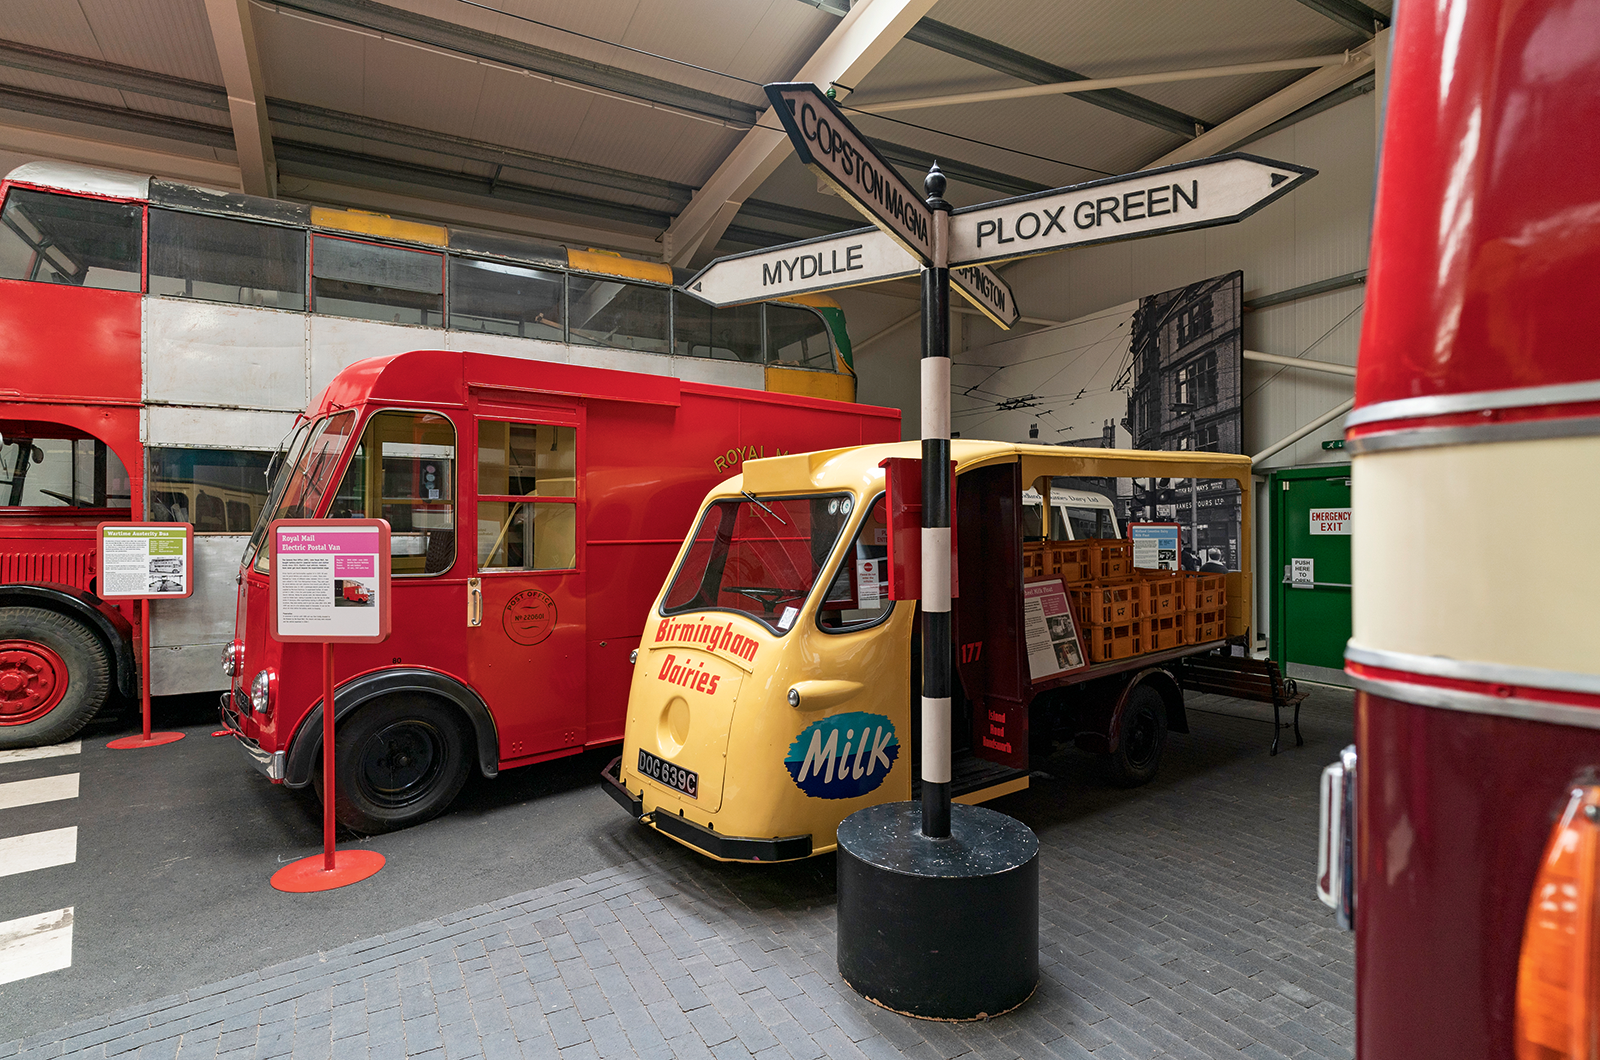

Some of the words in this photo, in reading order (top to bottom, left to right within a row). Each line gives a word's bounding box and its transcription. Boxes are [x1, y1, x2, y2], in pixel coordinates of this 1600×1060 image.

[802, 102, 883, 205] COPSTON
[886, 181, 928, 246] MAGNA
[976, 206, 1066, 248] PLOX
[1074, 180, 1198, 229] GREEN
[763, 244, 864, 286] MYDLLE
[714, 445, 764, 473] ROYAL
[1312, 512, 1352, 522] EMERGENCY
[1320, 522, 1343, 531] EXIT
[507, 593, 524, 611] POST
[527, 592, 553, 608] OFFICE
[655, 616, 759, 662] Birmingham
[961, 641, 983, 664] 177
[658, 654, 721, 695] Dairies
[988, 709, 1006, 723] Island
[639, 752, 660, 778] DOG
[662, 763, 695, 794] 639C
[797, 726, 892, 784] Milk
